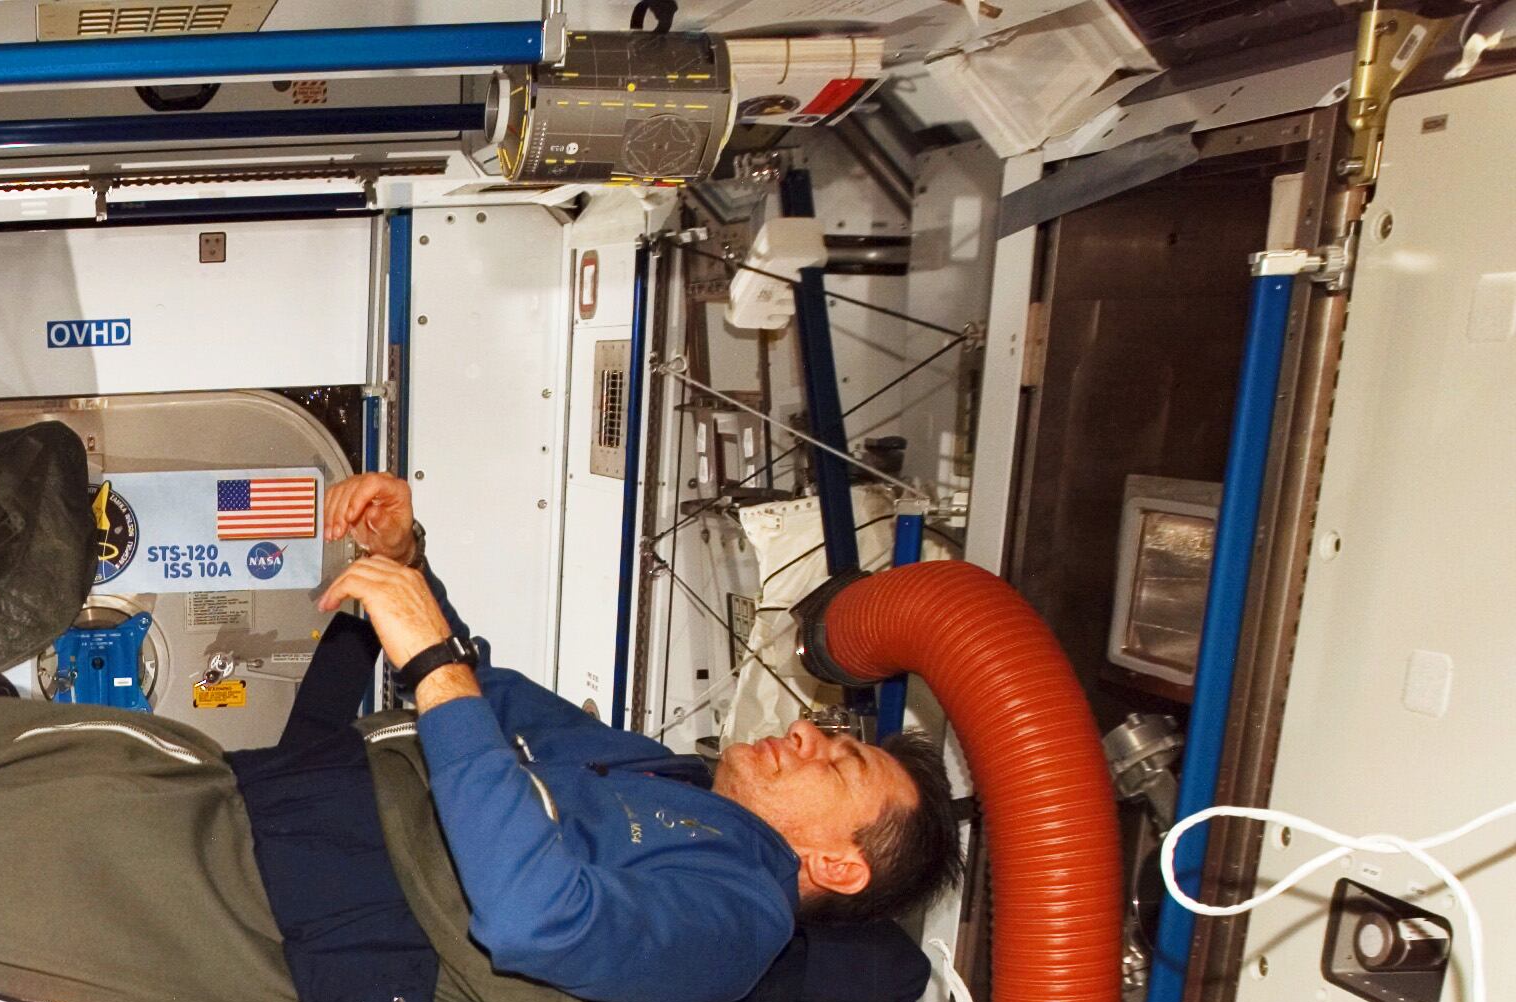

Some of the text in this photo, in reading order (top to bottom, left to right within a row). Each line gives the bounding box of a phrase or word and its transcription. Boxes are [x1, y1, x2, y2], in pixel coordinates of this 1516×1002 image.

[50, 322, 130, 346] OVHD
[147, 544, 218, 562] STS-120
[248, 556, 282, 566] NASA
[164, 561, 232, 579] ISS 10A
